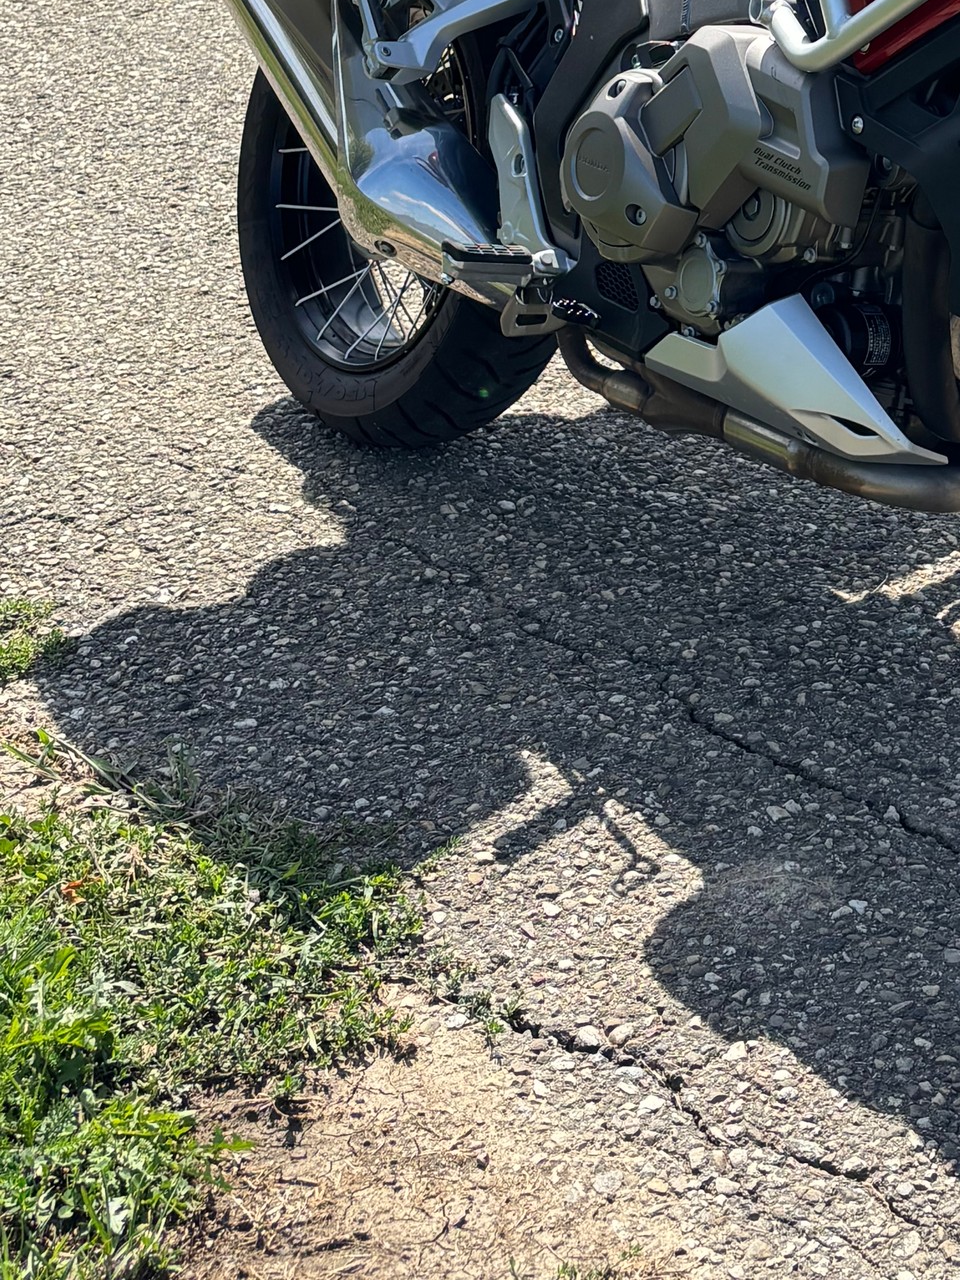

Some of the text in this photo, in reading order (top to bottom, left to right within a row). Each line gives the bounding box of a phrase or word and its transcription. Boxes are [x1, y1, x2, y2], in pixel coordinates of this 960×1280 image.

[753, 147, 802, 175] Dual Clutch
[754, 158, 812, 191] Transmission
